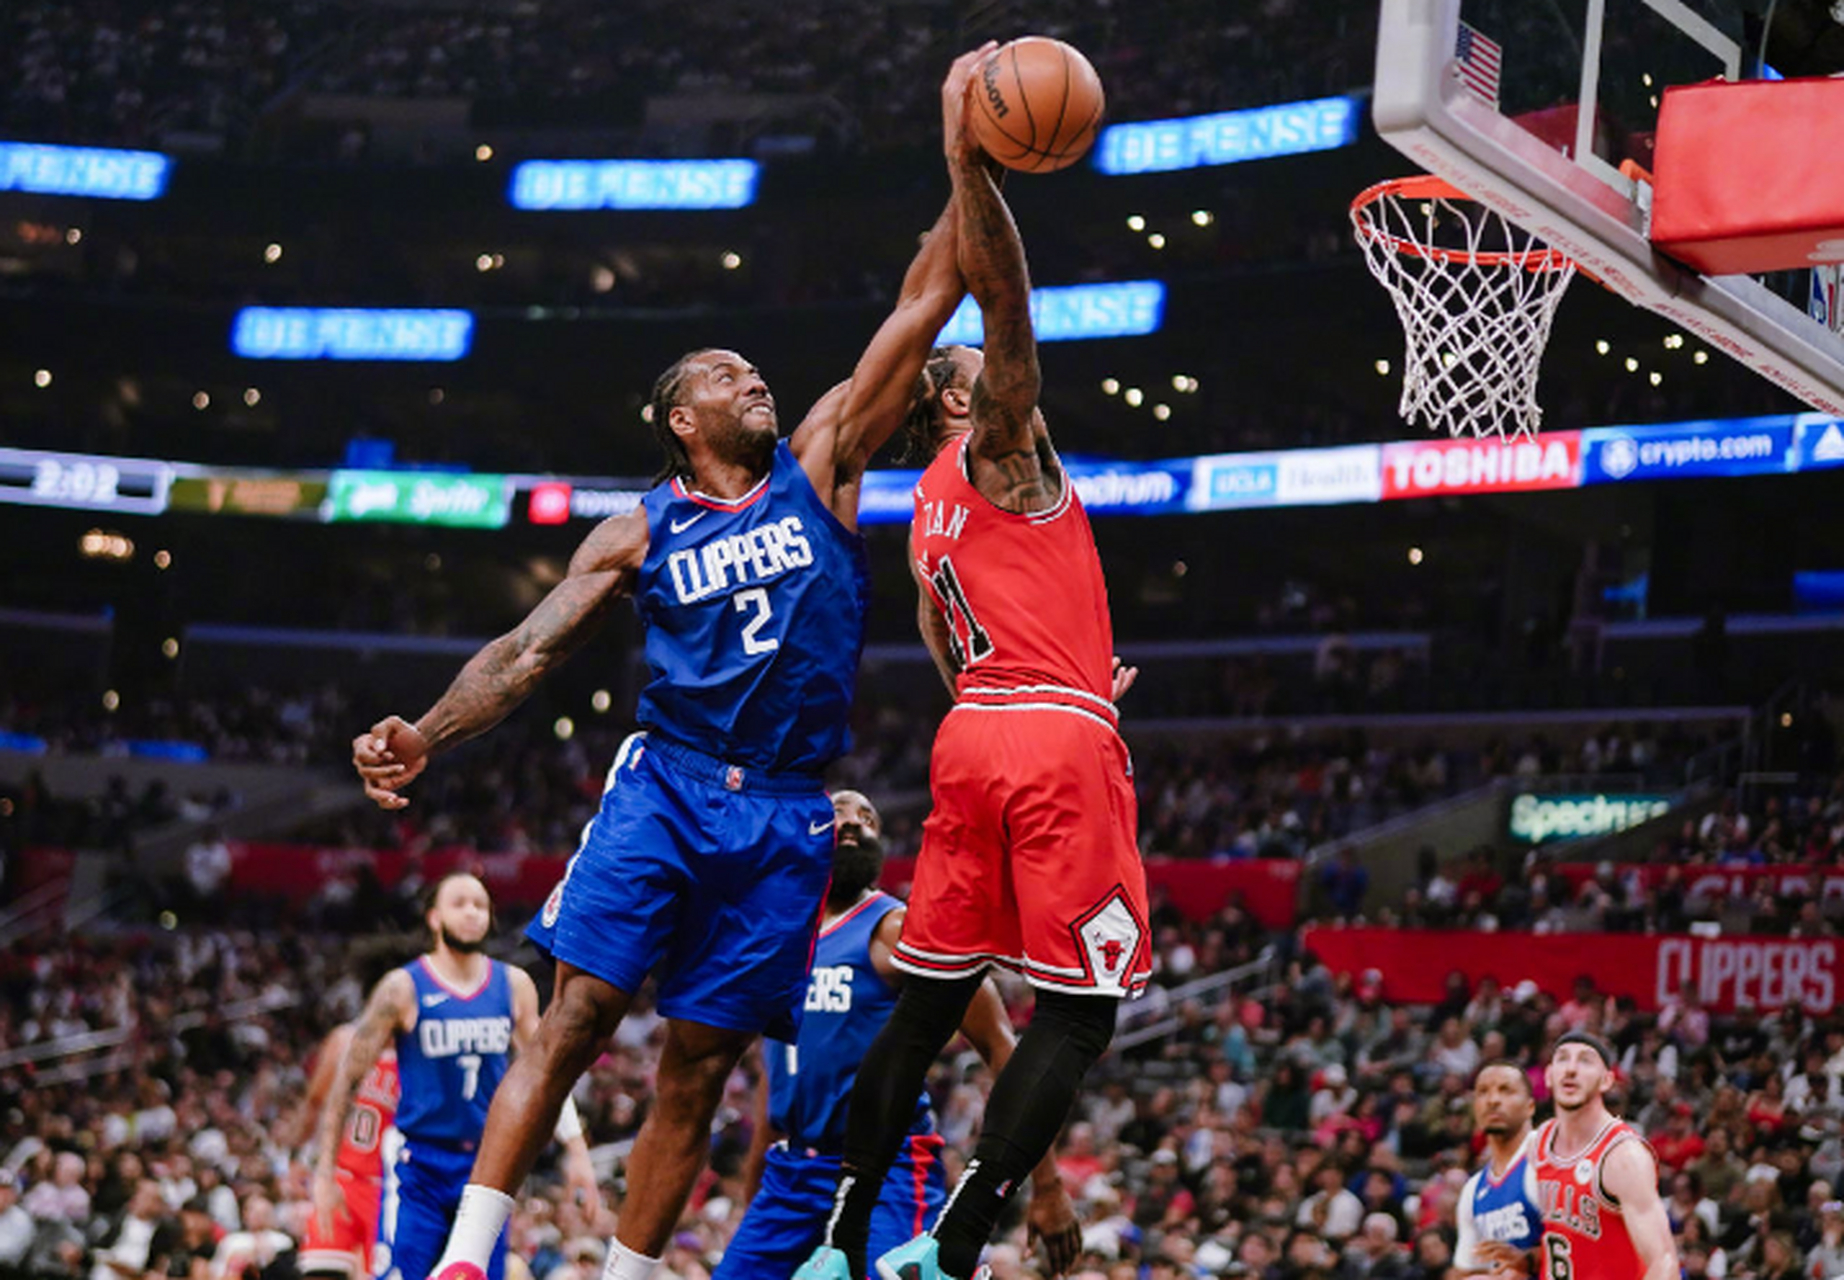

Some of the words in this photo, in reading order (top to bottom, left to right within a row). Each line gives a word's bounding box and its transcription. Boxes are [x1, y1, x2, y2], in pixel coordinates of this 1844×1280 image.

[1106, 98, 1350, 174] DEFENSE
[1390, 441, 1570, 490] TOSHIBA
[1640, 434, 1772, 467] crypto.com
[34, 459, 119, 503] 2:02
[918, 490, 970, 540] ZAN
[668, 516, 814, 605] CLIPPERS
[733, 587, 779, 655] 2
[804, 965, 853, 1012] ERS
[420, 1016, 511, 1057] CLIPPERS
[456, 1054, 482, 1100] 7
[1543, 1232, 1574, 1280] 6
